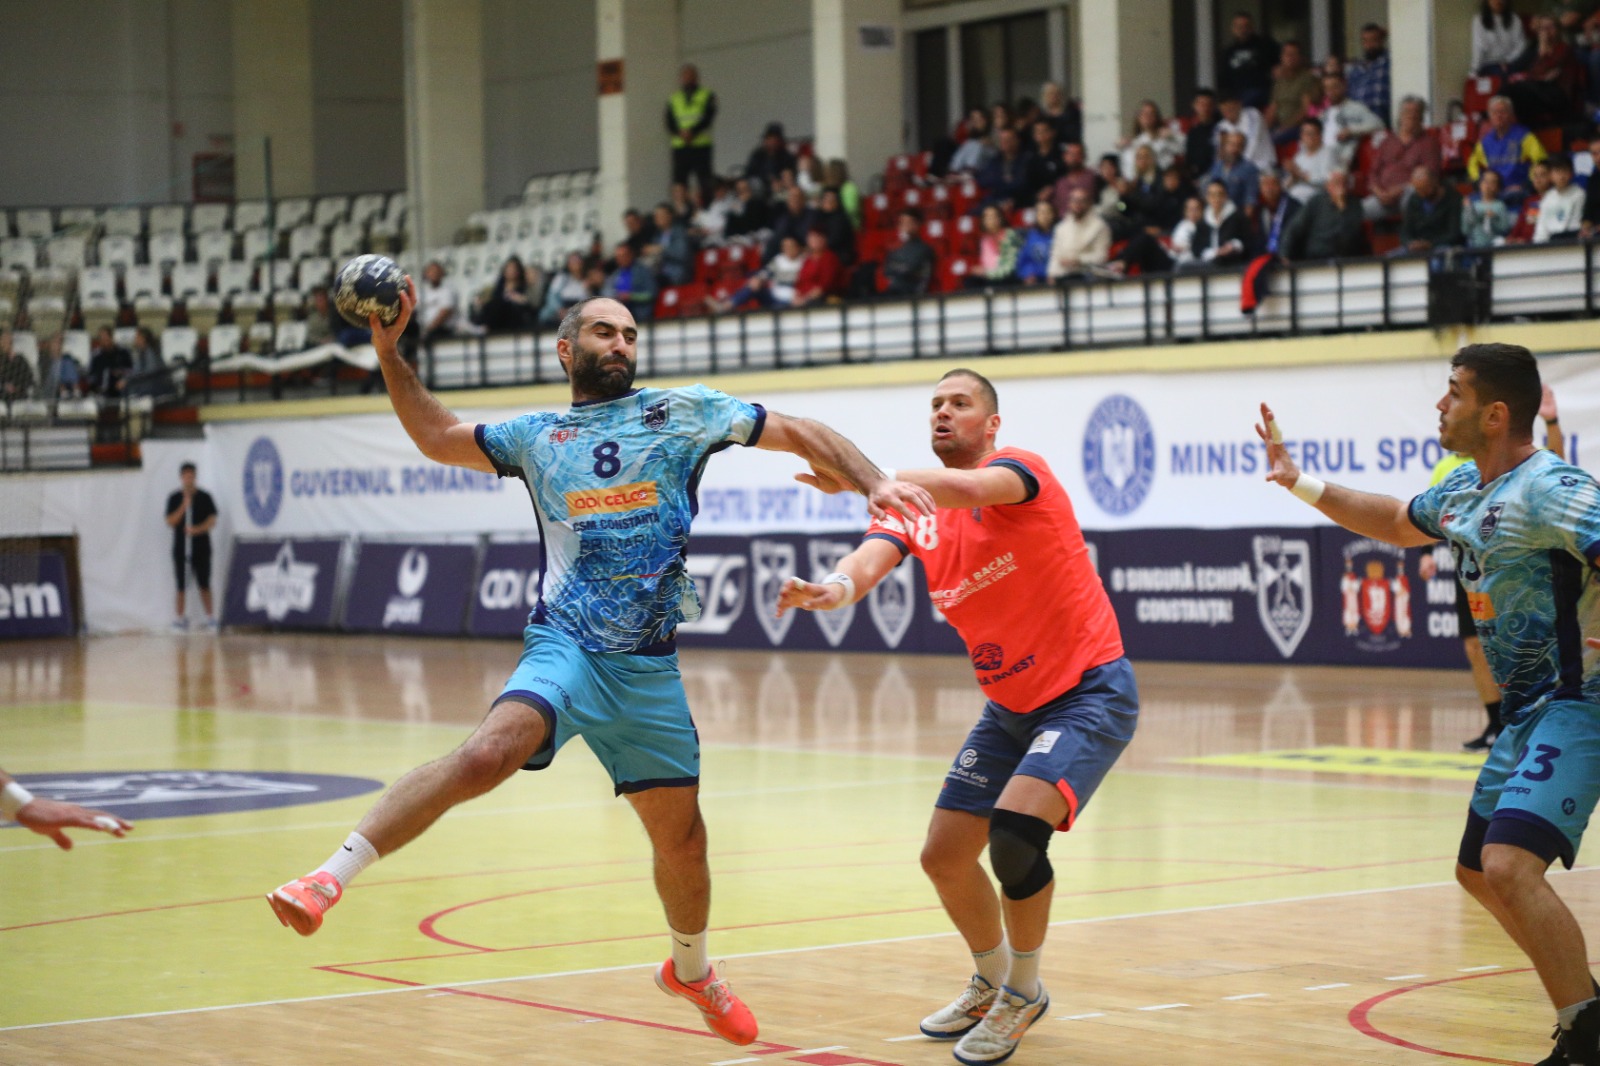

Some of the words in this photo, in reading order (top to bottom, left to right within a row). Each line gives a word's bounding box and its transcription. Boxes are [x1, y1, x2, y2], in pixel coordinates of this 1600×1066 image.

[593, 441, 621, 479] 8
[291, 468, 395, 497] GUVERNUL
[572, 520, 597, 532] CSM
[992, 654, 1036, 683] INVEST
